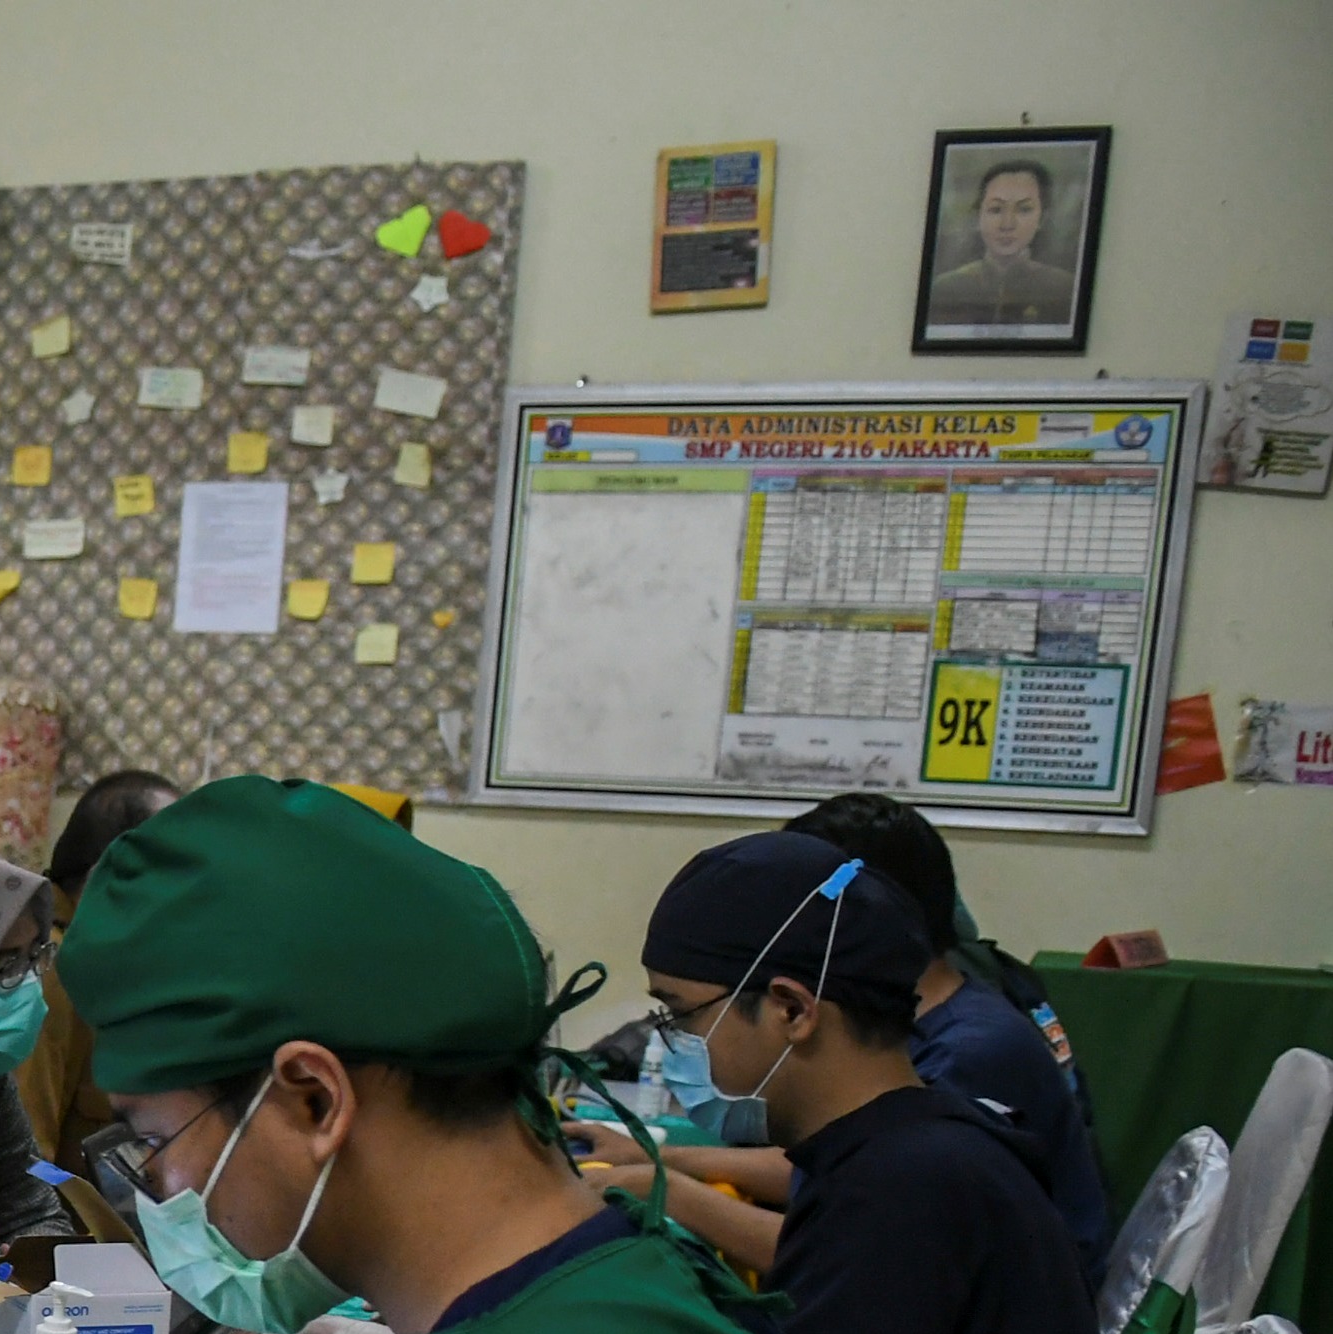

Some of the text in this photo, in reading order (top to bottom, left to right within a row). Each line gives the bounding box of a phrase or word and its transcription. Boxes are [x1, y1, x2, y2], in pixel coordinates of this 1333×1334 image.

[667, 415, 1017, 436] DATA ADMINISTRASI KELAS
[685, 440, 991, 458] SMP NEGERI 216 JAKARTA
[938, 698, 991, 747] 9K
[41, 1305, 89, 1317] ORON
